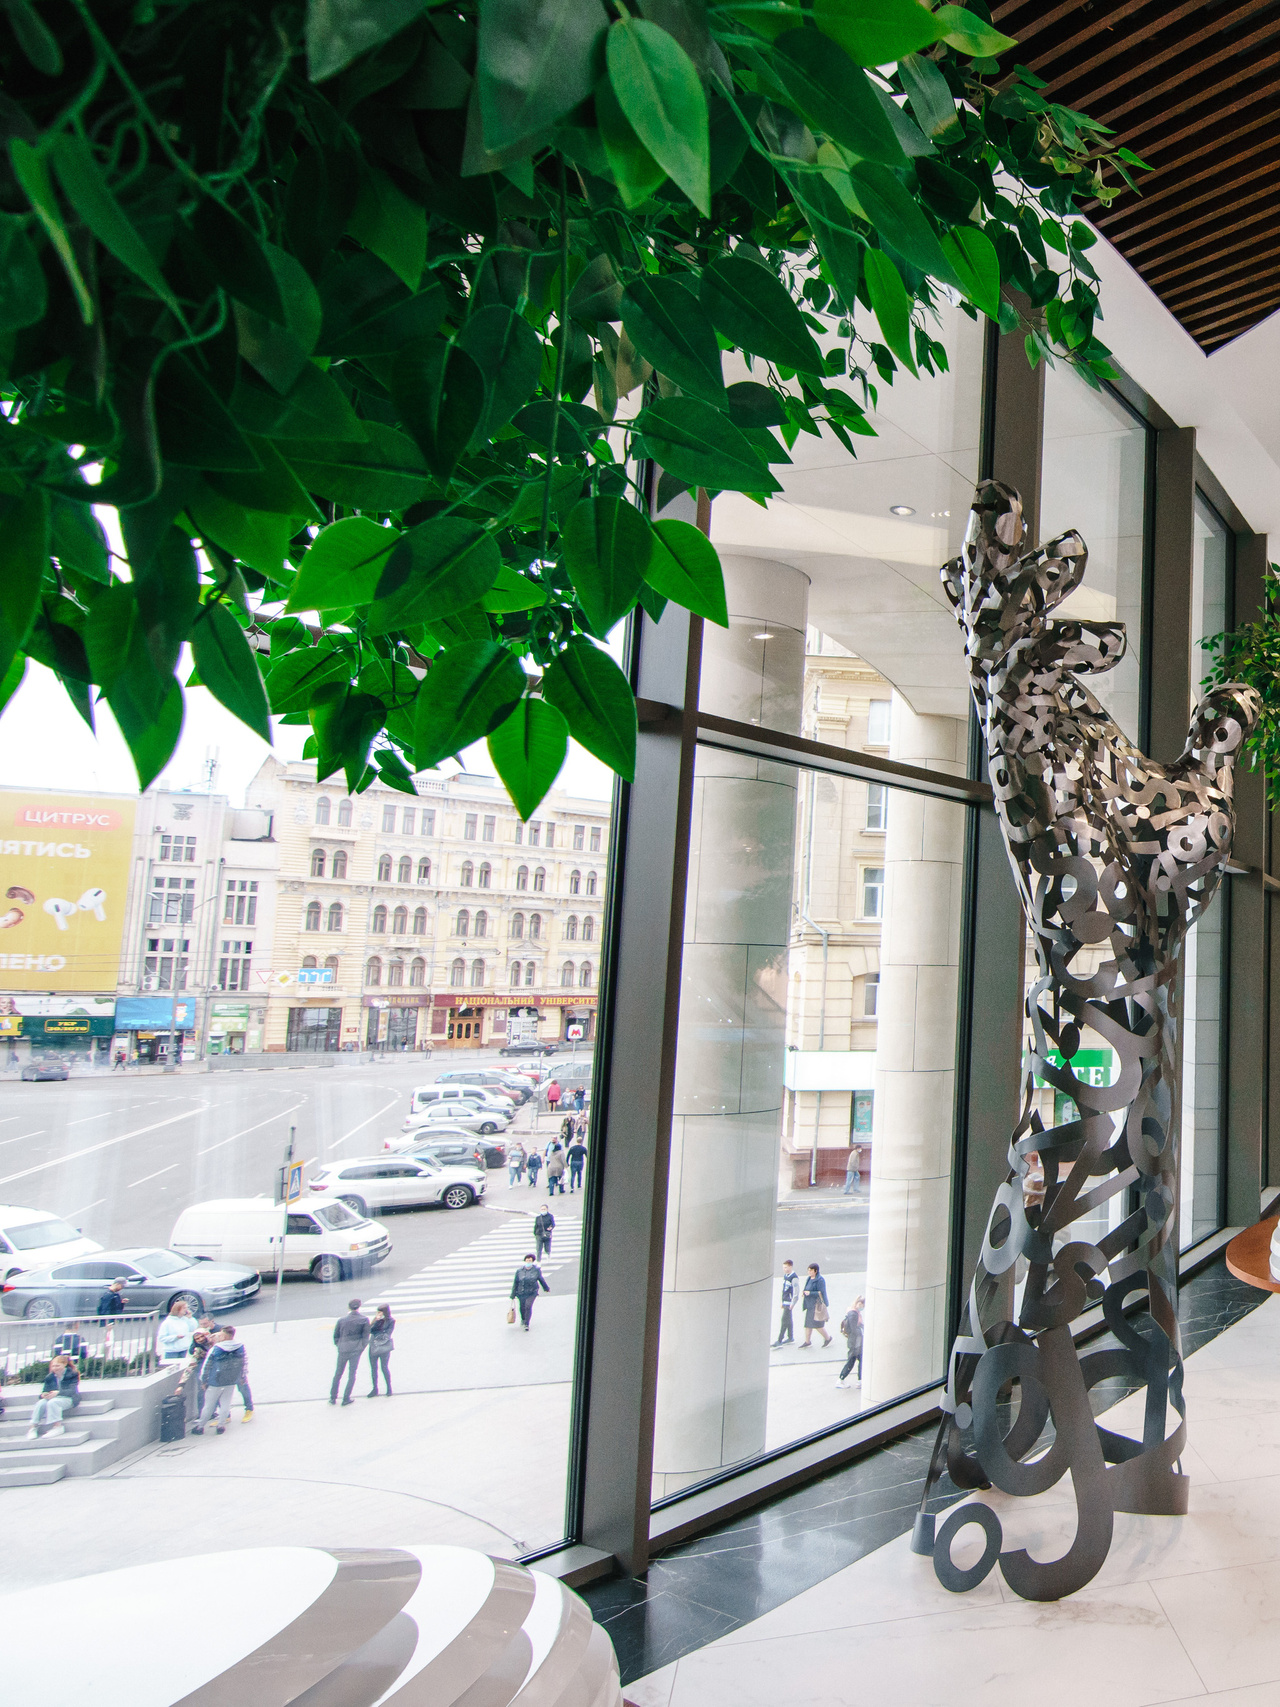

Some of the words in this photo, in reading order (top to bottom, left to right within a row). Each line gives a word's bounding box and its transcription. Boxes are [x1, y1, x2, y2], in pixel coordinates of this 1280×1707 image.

[24, 810, 110, 826] ЦИТРУС
[0, 840, 91, 858] ЯТИСЬ
[455, 996, 534, 1006] НАЦІОНАЛЬНИЙ
